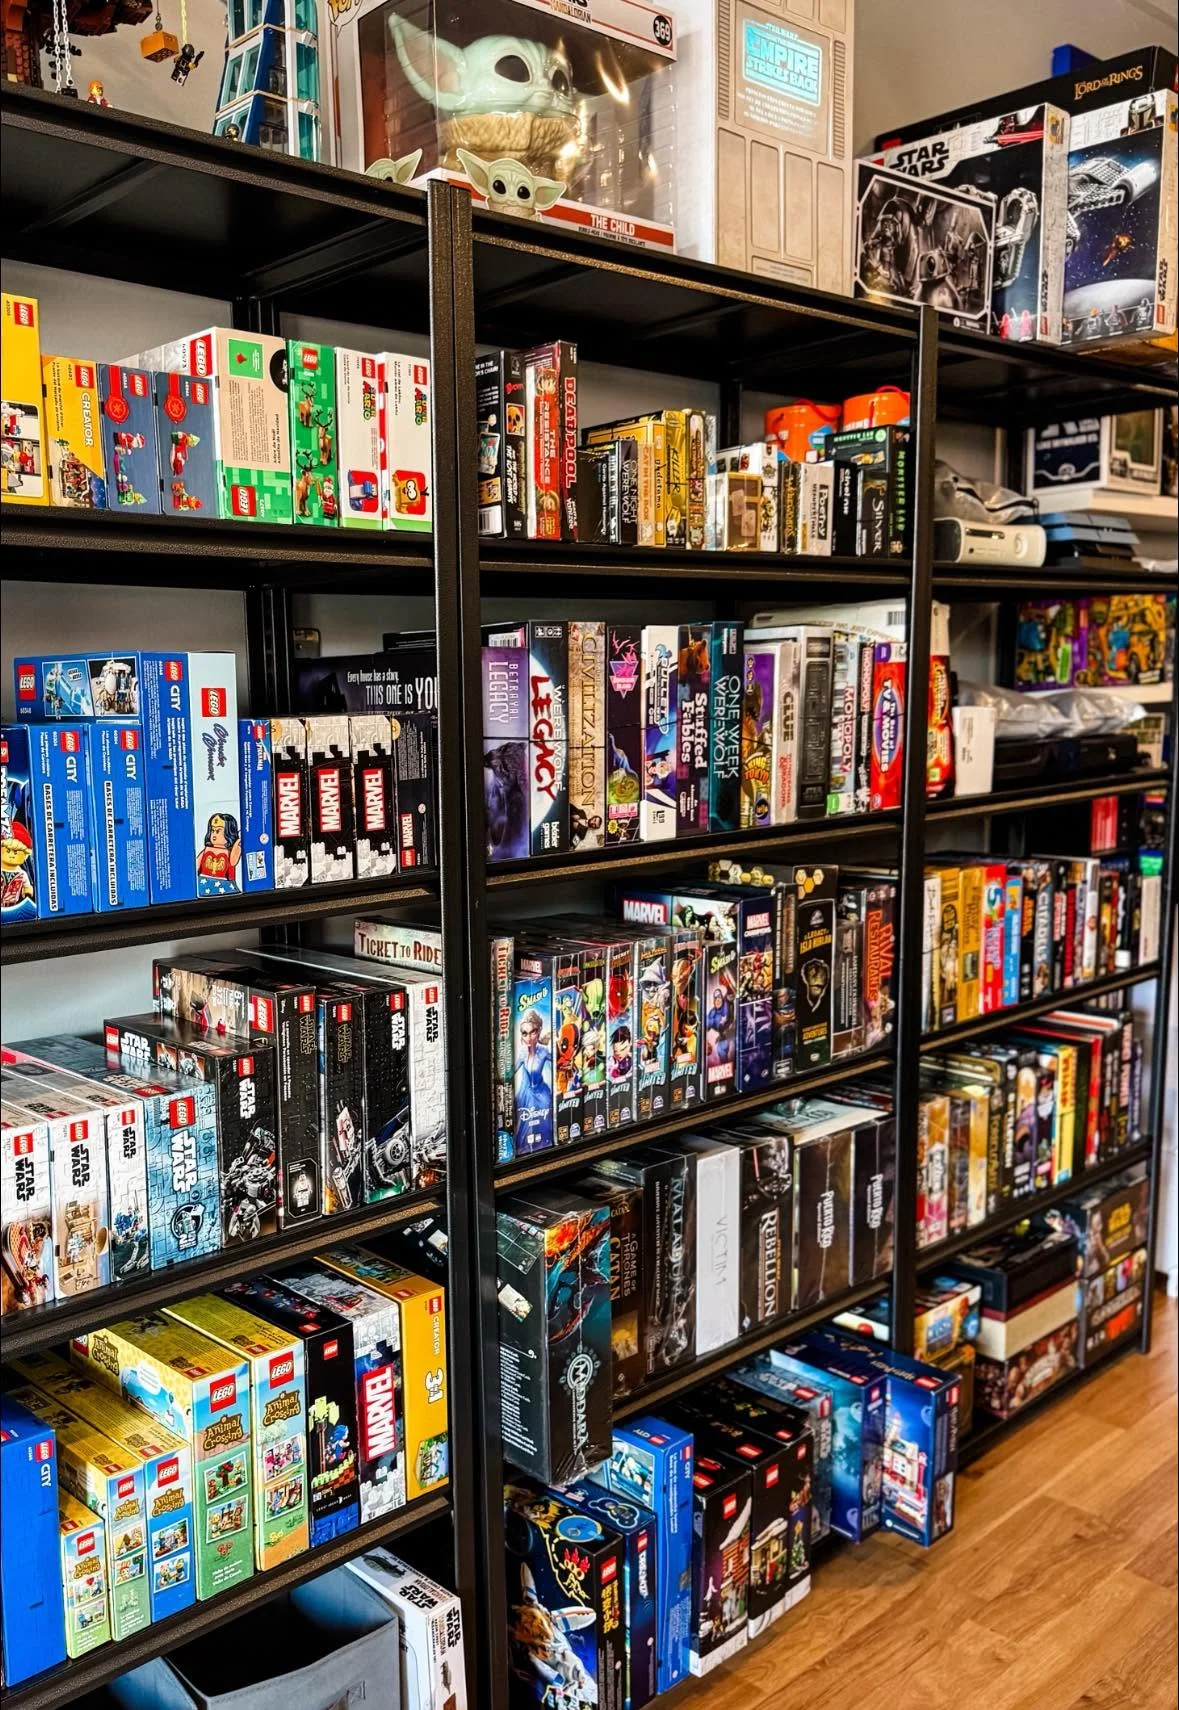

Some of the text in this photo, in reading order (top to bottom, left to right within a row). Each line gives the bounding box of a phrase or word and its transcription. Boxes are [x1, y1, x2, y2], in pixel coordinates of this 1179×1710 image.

[654, 20, 671, 41] 369
[746, 27, 819, 80] EMPIRE
[1074, 64, 1144, 100] LORD RINGS
[889, 141, 949, 169] STAR
[591, 214, 609, 231] THE
[609, 218, 635, 237] CHILD
[196, 339, 206, 377] LEGO
[82, 392, 94, 447] CREATOR
[363, 381, 371, 420] MARIO
[565, 377, 577, 488] DEADPOOL
[239, 488, 250, 514] LEGO
[819, 486, 829, 537] Poetry
[19, 677, 34, 690] LEGO
[347, 671, 359, 685] Every
[360, 669, 372, 683] house
[373, 668, 381, 682] has
[386, 667, 400, 684] story.
[366, 684, 384, 705] THIS
[386, 684, 402, 705] ONE
[404, 683, 413, 704] IS
[488, 661, 508, 724] LEGACY
[508, 663, 519, 721] BETRAYAL
[860, 647, 873, 712] MONOPOLY
[170, 684, 181, 711] CITY
[207, 688, 220, 718] LEGO
[782, 691, 795, 742] CLUE
[531, 675, 556, 801] LEGACY
[553, 685, 565, 792] WEREWOLF
[581, 631, 598, 809] CIVILIZATION
[682, 700, 692, 764] Fables
[694, 692, 708, 769] Stuffed
[713, 675, 727, 780] WEREWOLF
[726, 675, 742, 779] ONE WEEK
[841, 686, 855, 773] MONOPOLY
[881, 679, 892, 772] TV MOVIES
[202, 732, 216, 782] Woman
[213, 723, 229, 768] Wonder
[748, 756, 767, 769] KING
[66, 755, 78, 783] CITY
[126, 754, 136, 781] CITY
[744, 767, 769, 785] TOKYO
[47, 811, 53, 822] DE
[106, 807, 112, 817] DE
[279, 773, 300, 837] MARVEL
[320, 770, 341, 832] MARVEL
[364, 770, 385, 831] MARVEL
[47, 823, 56, 867] CARRETERA
[107, 818, 115, 862] CARRETERA
[402, 814, 413, 848] MARVEL
[49, 868, 57, 911] INCLUIDAS
[109, 863, 117, 905] INCLUIDAS
[623, 900, 668, 924] MARVEL
[746, 912, 770, 930] MARVEL
[358, 932, 442, 966] TICKET TO RIDE
[520, 958, 543, 975] MARVEL
[867, 909, 881, 1001] RESTAURANTS
[880, 922, 895, 978] RIVAL
[257, 996, 268, 1032] LEGO
[430, 1007, 439, 1042] STAR
[499, 1007, 509, 1038] RIDE
[121, 1031, 150, 1051] STAR
[121, 1043, 150, 1062] WARS
[299, 1014, 309, 1055] WARS
[610, 1082, 631, 1096] UNITED
[638, 1071, 667, 1092] UNITED
[670, 1062, 698, 1081] UNITED
[707, 1062, 733, 1083] MARVEL
[239, 1079, 249, 1119] WARS
[246, 1079, 256, 1118] STAR
[558, 1098, 580, 1112] UNITED
[584, 1089, 604, 1103] UNITED
[123, 1128, 131, 1159] WARS
[181, 1130, 198, 1193] STAR
[15, 1157, 26, 1202] WARS
[24, 1157, 35, 1199] STAR
[71, 1144, 82, 1187] WARS
[80, 1144, 90, 1186] STAR
[170, 1133, 186, 1193] WARS
[820, 1190, 835, 1249] PUERTO RICO
[870, 1173, 883, 1229] PUERTO RICO
[610, 1236, 621, 1301] CATAN
[621, 1232, 631, 1297] THRONES
[630, 1240, 638, 1277] GAME
[760, 1209, 778, 1318] REBELLION
[432, 1315, 441, 1356] CREATOR
[270, 1361, 294, 1379] LEGO
[210, 1383, 235, 1403] LEGO
[266, 1392, 300, 1415] Animal
[206, 1416, 241, 1439] Animal
[263, 1403, 300, 1428] Crossing
[366, 1366, 396, 1459] MARVEL
[203, 1428, 244, 1451] Crossing
[41, 1463, 51, 1488] CITY
[118, 1481, 134, 1495] LEGO
[158, 1464, 178, 1479] LEGO
[155, 1490, 183, 1508] Animal
[78, 1537, 94, 1551] LEGO
[399, 1586, 432, 1609] STAR
[407, 1584, 439, 1609] WARS
[446, 1608, 456, 1649] WARS
[453, 1606, 462, 1646] STAR
